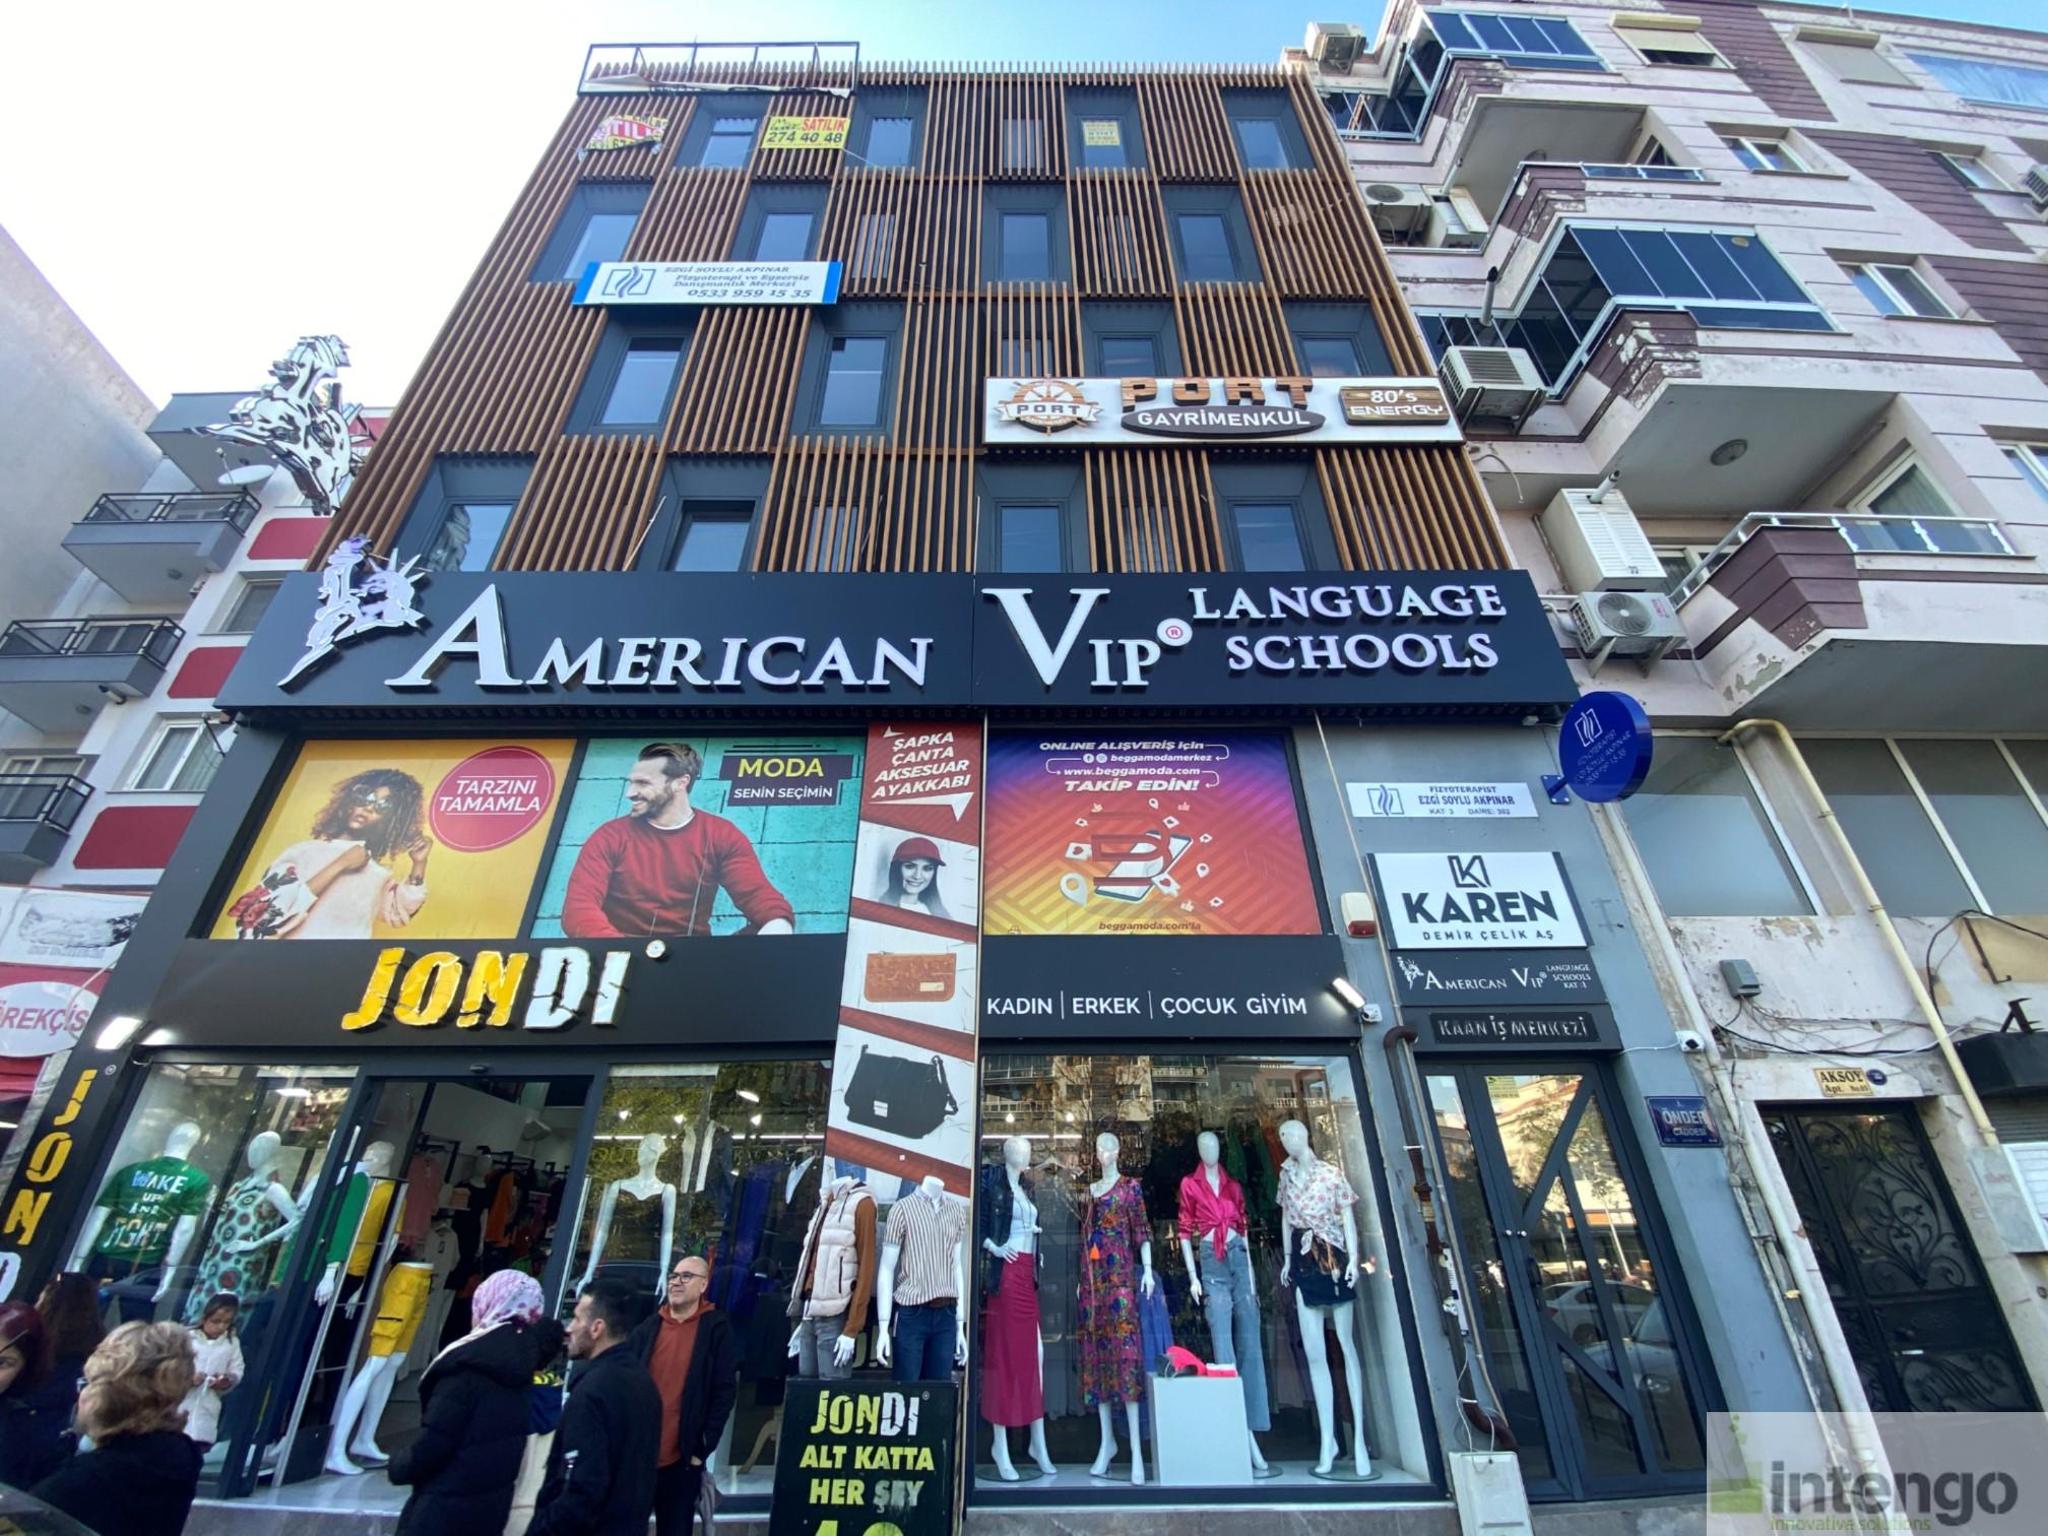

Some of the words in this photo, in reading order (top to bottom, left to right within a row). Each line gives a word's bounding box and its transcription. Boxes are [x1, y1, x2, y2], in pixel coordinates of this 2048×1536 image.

[801, 118, 846, 132] SATILIK
[767, 131, 796, 143] 274
[800, 132, 820, 142] 40
[824, 132, 843, 143] 48
[687, 289, 728, 298] 0533
[732, 289, 764, 298] 959
[769, 289, 788, 298] 15
[790, 289, 813, 298] 35
[1119, 377, 1314, 412] PORT
[1369, 388, 1418, 405] 80's
[1017, 404, 1081, 415] PORT
[1136, 405, 1312, 428] GAYRİMENKUL
[1349, 404, 1445, 417] ENERGY
[1187, 584, 1509, 620] LANGUAGE
[1226, 632, 1500, 672] SCHOOLS
[892, 731, 954, 752] ŞAPKA
[1039, 742, 1096, 751] ONLINE
[891, 746, 955, 766] ÇANTA
[1110, 754, 1213, 763] beggamodamerkez
[737, 757, 824, 778] MODA
[874, 759, 970, 783] AKSESUAR
[1063, 766, 1201, 777] www.beggamoda.com
[455, 779, 538, 795] TARZINI
[733, 785, 775, 799] SENİN
[777, 784, 833, 800] SEÇİMİN
[871, 774, 972, 800] AYAKKABI
[1065, 778, 1133, 792] TAKİP
[1136, 778, 1200, 791] EDİN!
[438, 797, 541, 812] TAMAMLA
[1418, 793, 1440, 805] EZGİ
[1441, 795, 1471, 805] SOYLU
[1473, 795, 1516, 805] AKPINAR
[1401, 890, 1560, 923] KAREN
[1422, 929, 1474, 940] DEMİR
[1480, 929, 1528, 943] ÇELİK
[1545, 963, 1591, 972] LANGUAGE
[1424, 969, 1509, 990] AMERICAN
[1552, 973, 1592, 981] SCHOOLS
[341, 946, 632, 1031] JONDI
[986, 997, 1053, 1015] KADIN
[1072, 997, 1141, 1014] ERKEK
[1160, 996, 1238, 1018] ÇOCUK
[1246, 993, 1308, 1015] GİYİM
[1438, 1019, 1488, 1036] KAAN
[1489, 1015, 1508, 1041] İŞ
[1511, 1016, 1589, 1037] MERKEZİ
[1820, 1070, 1864, 1083] AKSOY
[1662, 1107, 1707, 1125] ÖNDER
[131, 1169, 189, 1194] WAKE
[810, 1390, 921, 1437] JONDI
[800, 1444, 848, 1469] ALT
[854, 1446, 936, 1471] KATTA
[809, 1478, 866, 1505] HER
